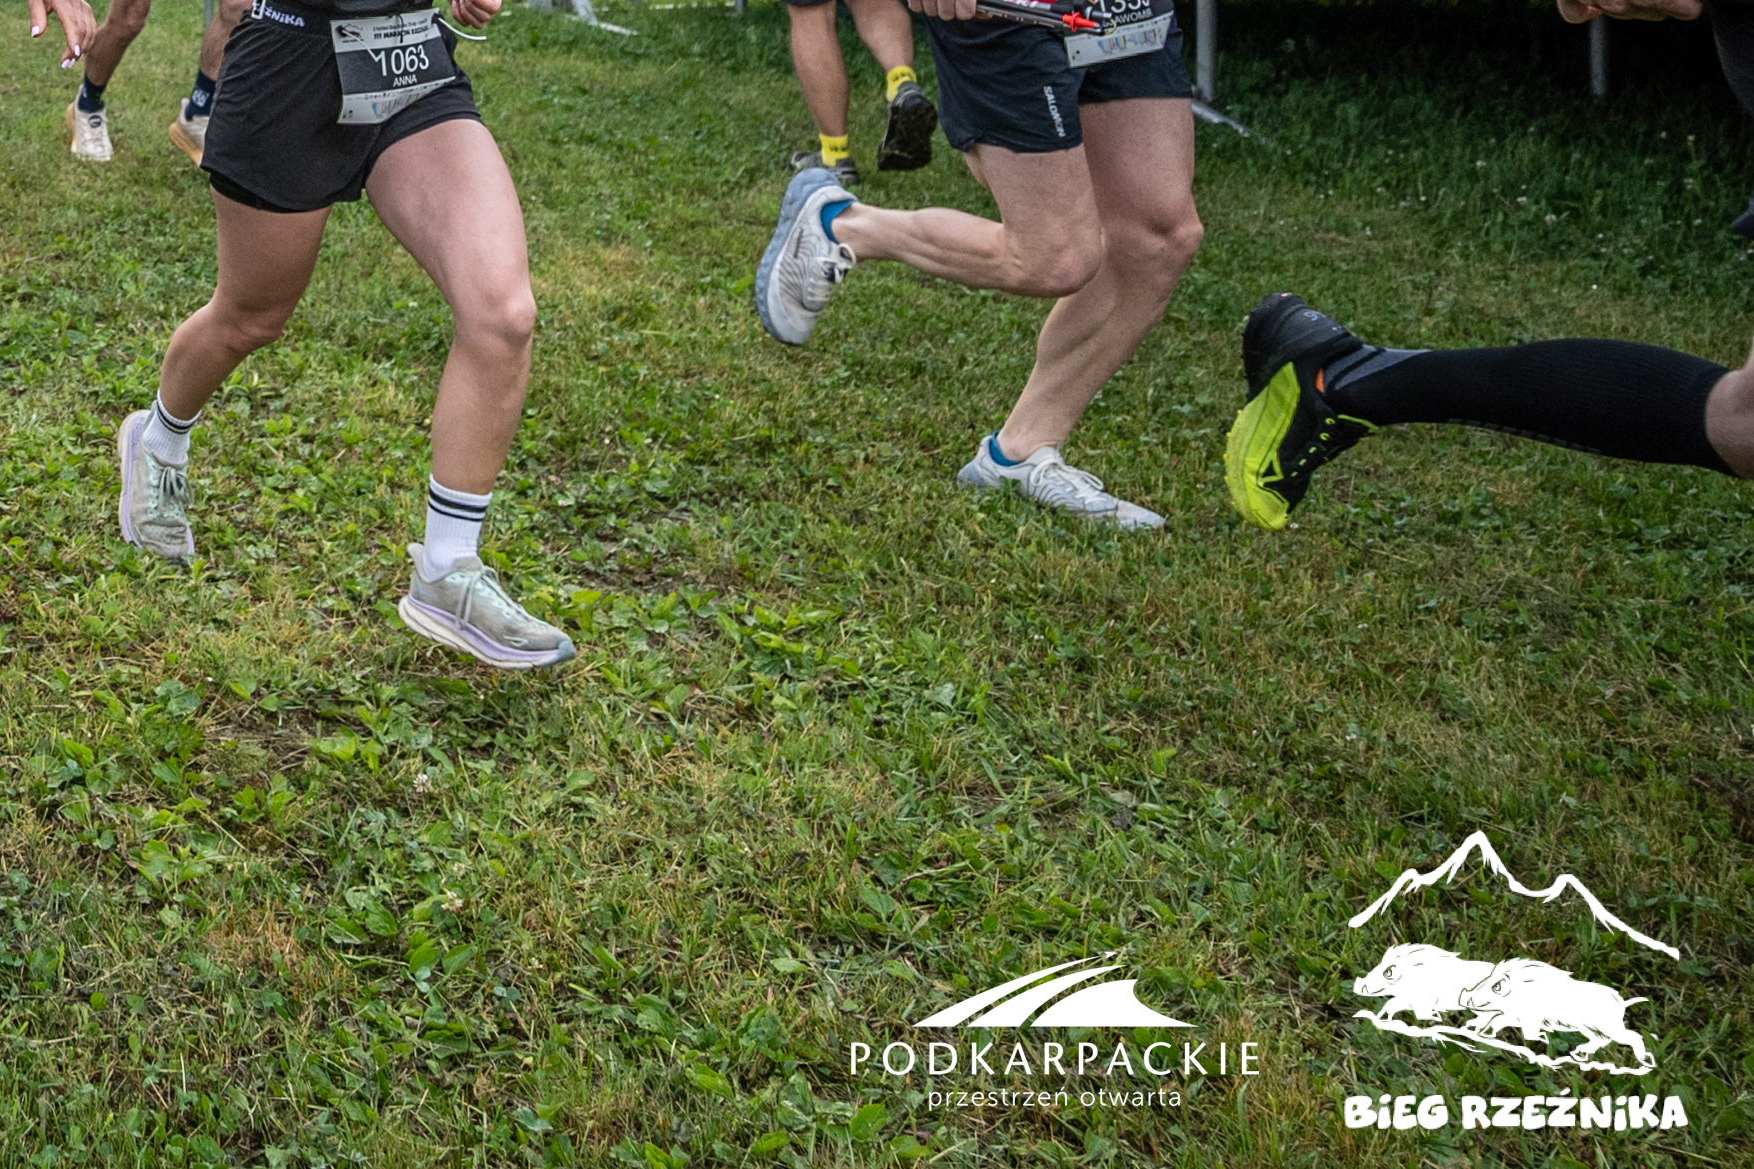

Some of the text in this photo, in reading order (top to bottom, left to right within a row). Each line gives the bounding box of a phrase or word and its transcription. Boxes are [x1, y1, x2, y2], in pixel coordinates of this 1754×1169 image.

[375, 44, 430, 77] 1063
[392, 74, 418, 88] ANNA
[1043, 86, 1066, 138] SALOMON
